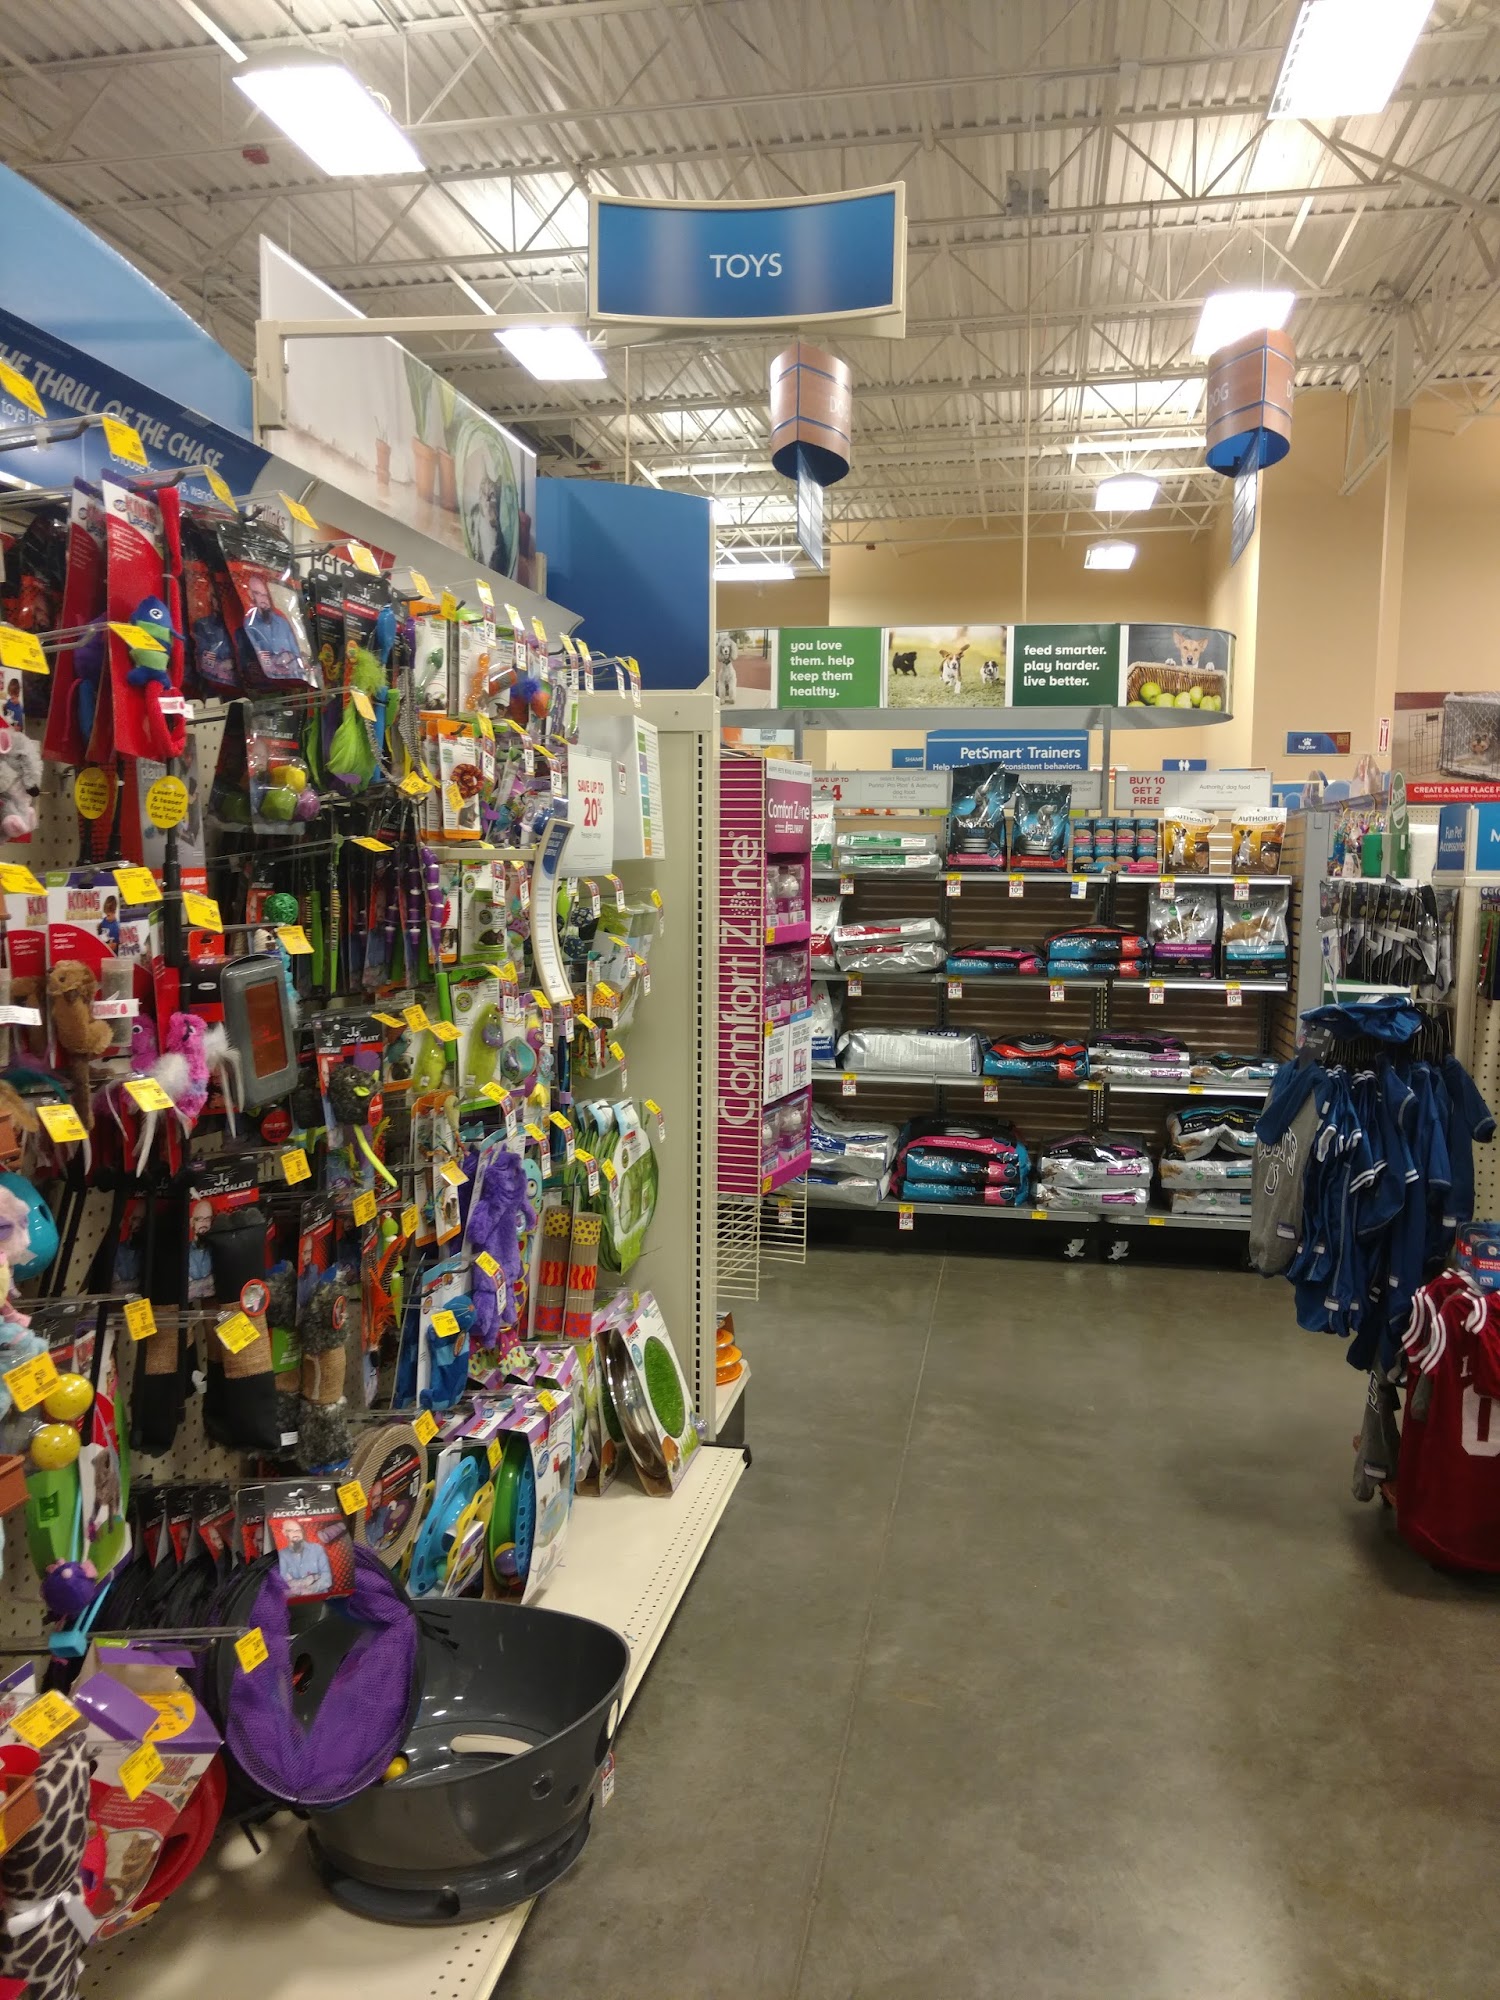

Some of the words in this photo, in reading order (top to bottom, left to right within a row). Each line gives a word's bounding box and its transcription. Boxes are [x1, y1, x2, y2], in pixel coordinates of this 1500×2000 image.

[709, 252, 783, 279] TOYS
[34, 361, 101, 415] THRILL
[101, 399, 135, 426] OF
[134, 411, 171, 449] THE
[168, 433, 224, 469] CHASE
[790, 642, 813, 653] you
[817, 640, 842, 650] love
[1024, 645, 1052, 656] feed
[1055, 645, 1107, 655] smarter.
[790, 656, 825, 666] them.
[828, 655, 855, 668] help
[1024, 660, 1052, 673] play
[1056, 660, 1100, 671] harder.
[790, 671, 819, 683] keep
[821, 671, 853, 681] them
[1024, 676, 1046, 687] live
[1049, 676, 1090, 686] better.
[790, 686, 840, 699] healthy.
[960, 747, 1024, 760] PetSmart
[1026, 747, 1081, 760] Trainers
[933, 763, 950, 771] Help
[1005, 763, 1043, 771] consistent
[1044, 762, 1083, 771] behaviors.
[1129, 776, 1151, 785] BUY
[1153, 777, 1165, 785] 10
[578, 779, 589, 793] SAVE
[591, 781, 597, 794] UP
[598, 781, 605, 795] TO
[1132, 786, 1152, 795] GET
[1155, 787, 1162, 795] 2
[1226, 783, 1236, 791] dog
[1413, 786, 1442, 794] CREATE
[1443, 786, 1449, 794] A
[153, 787, 172, 796] Laser
[174, 791, 186, 800] toy
[160, 797, 184, 806] teaser
[1134, 796, 1160, 805] FREE
[150, 803, 161, 811] for
[163, 806, 183, 814] twice
[768, 797, 793, 819] Comfort
[977, 820, 995, 828] PLAN
[1237, 815, 1280, 823] AUTHORITY
[1445, 826, 1454, 839] Fun
[1455, 827, 1463, 840] Pet
[67, 890, 100, 912] KONG
[1234, 900, 1280, 909] AUTHORITY
[720, 954, 760, 1127] Comfort
[198, 1186, 223, 1198] CKSON
[225, 1179, 253, 1193] GALAXY
[273, 1508, 306, 1518] JACKSON
[307, 1506, 337, 1516] GALAXY
